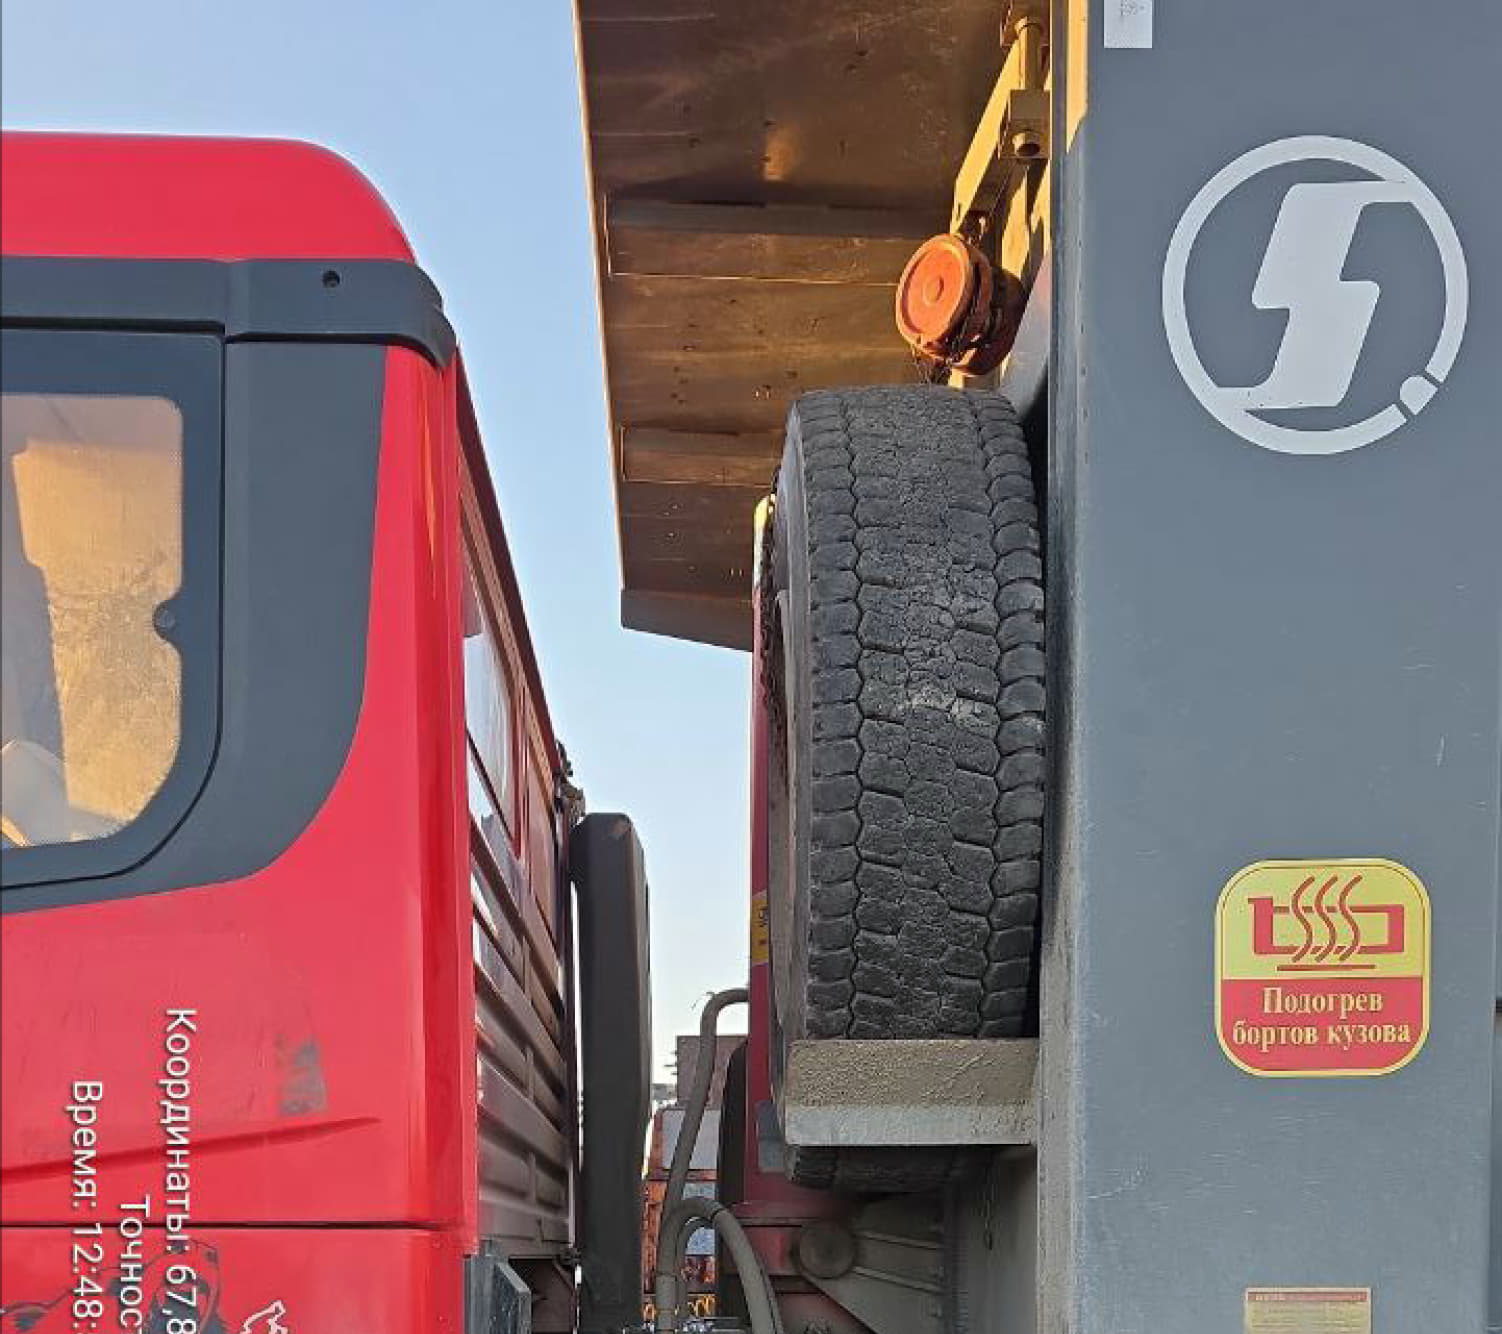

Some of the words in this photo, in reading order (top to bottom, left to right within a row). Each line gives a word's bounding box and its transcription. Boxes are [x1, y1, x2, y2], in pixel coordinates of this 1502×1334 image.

[1263, 987, 1383, 1020] Подогрев
[1233, 1021, 1319, 1052] бортов
[1328, 1024, 1411, 1050] кузова
